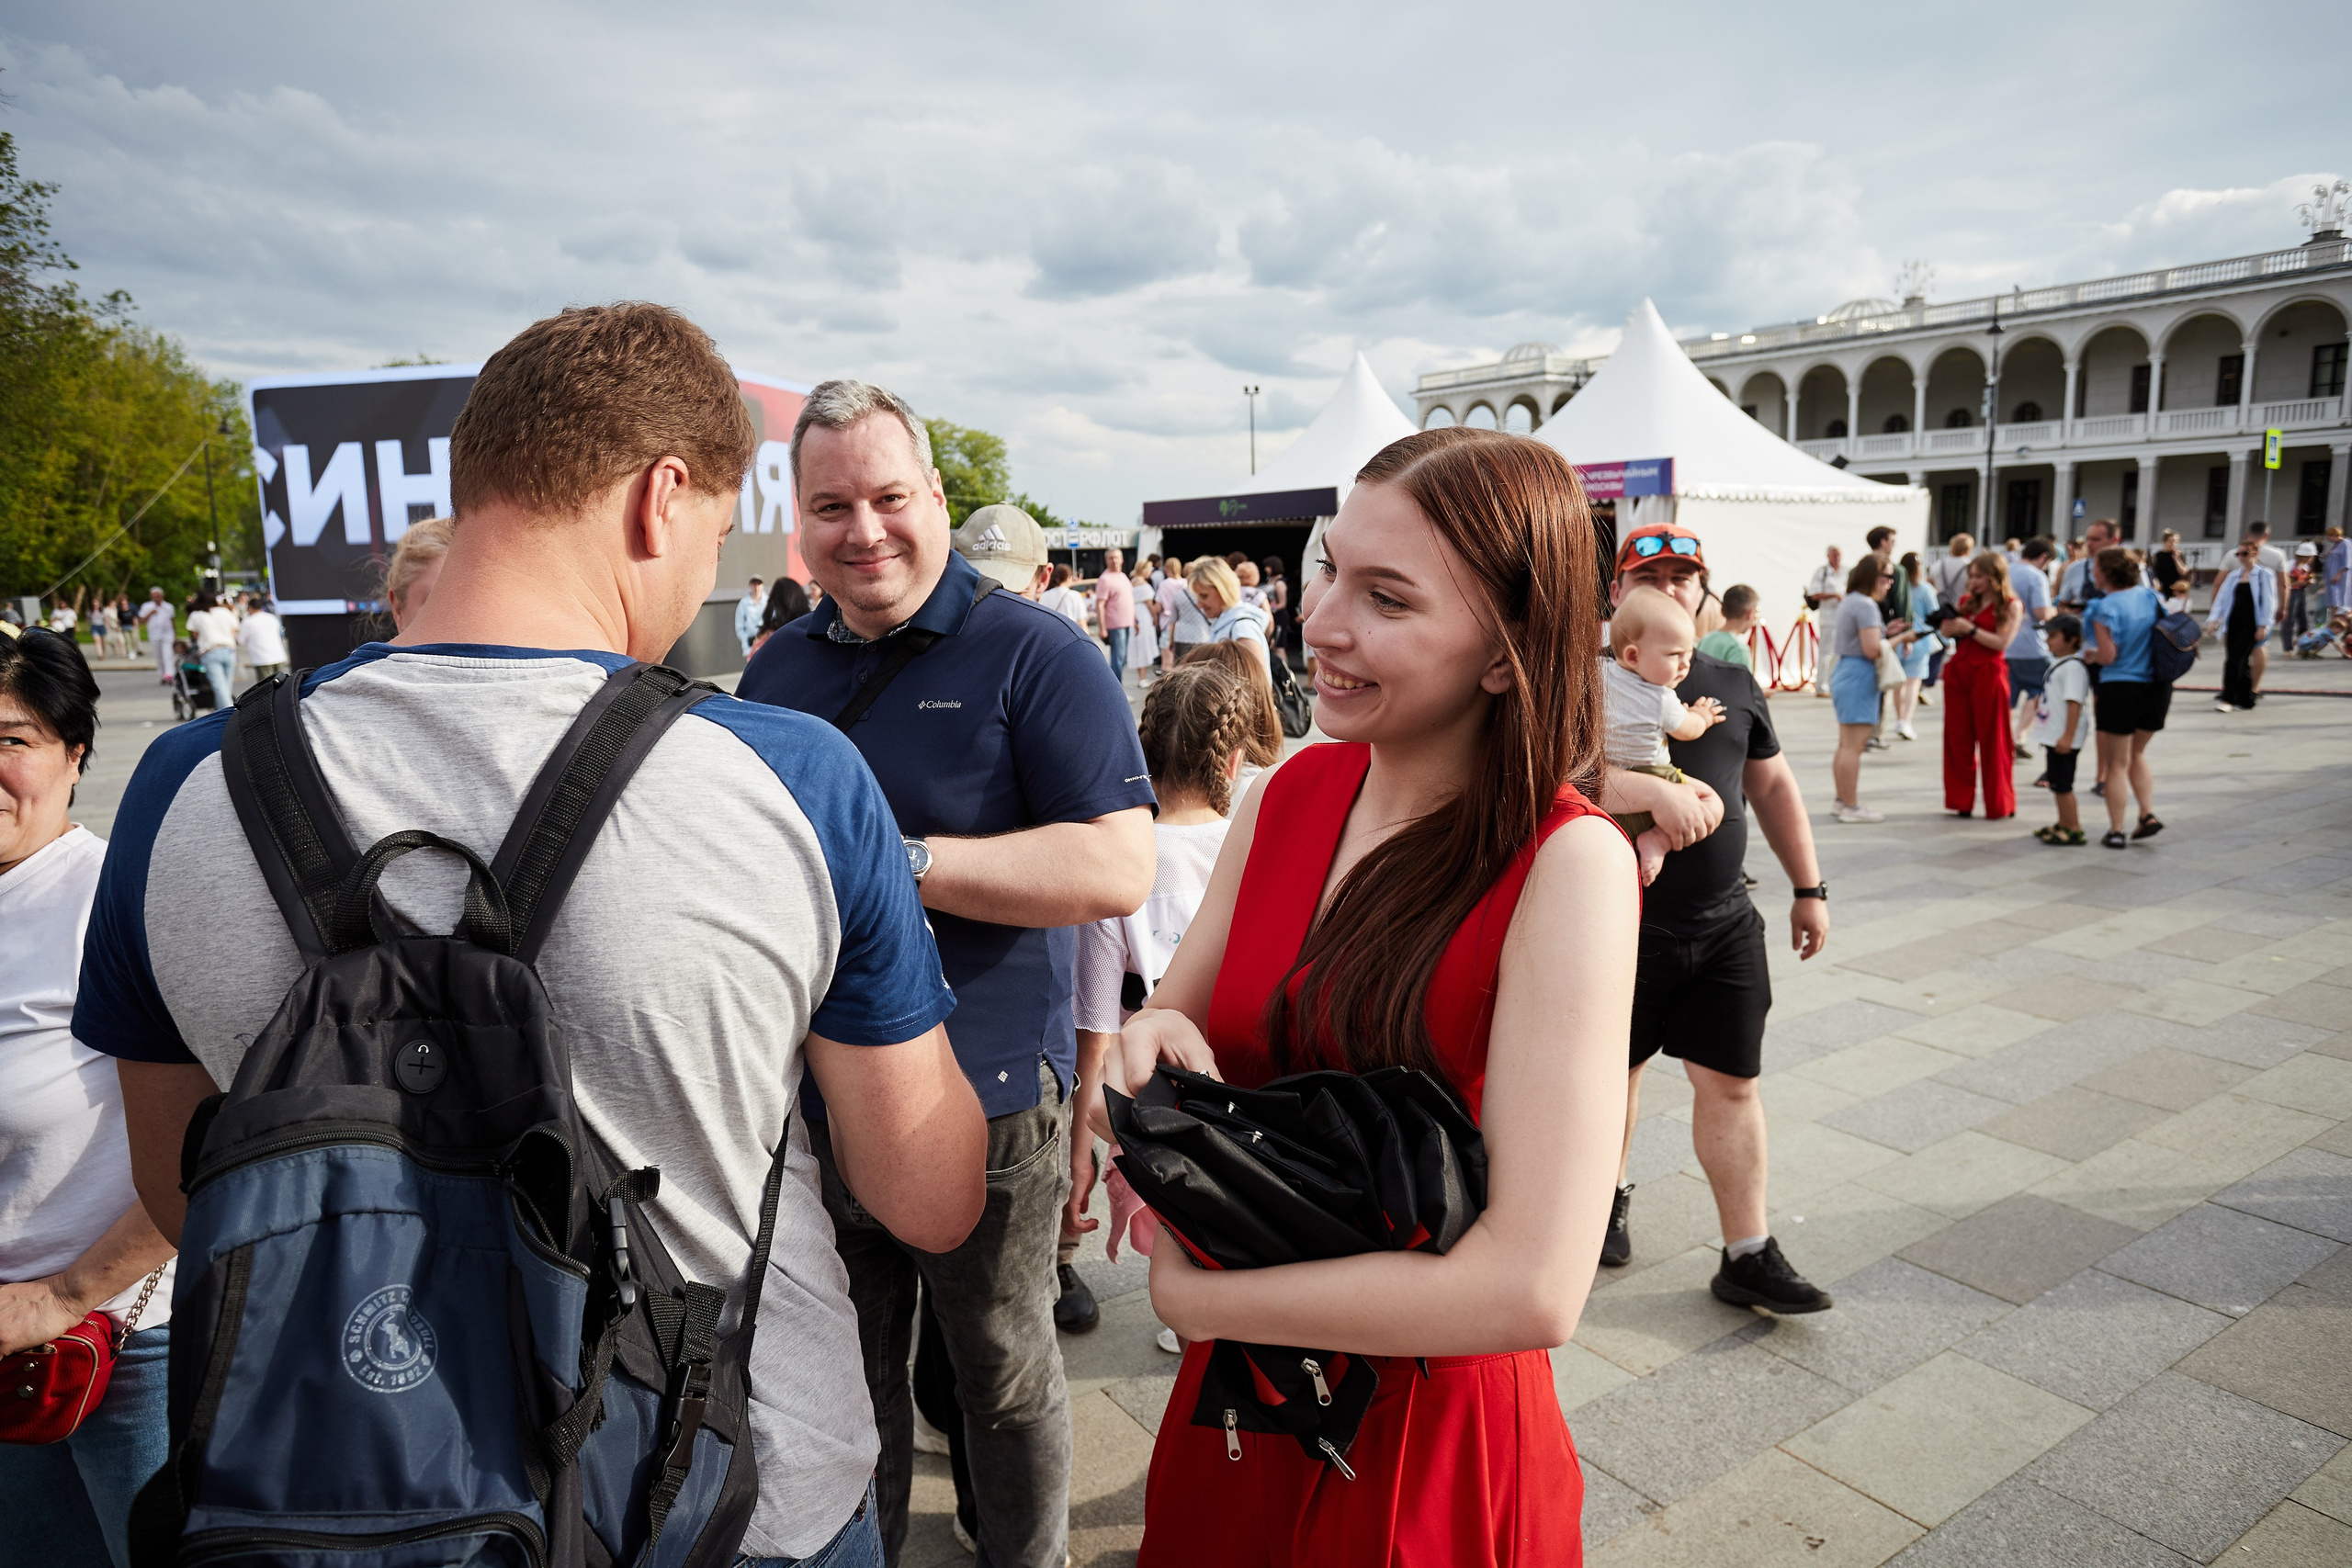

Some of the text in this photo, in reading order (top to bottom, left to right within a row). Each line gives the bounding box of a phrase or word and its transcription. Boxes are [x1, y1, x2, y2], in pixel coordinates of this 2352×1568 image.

[972, 539, 1011, 551] adidas
[926, 699, 962, 708] Columbia
[348, 1291, 396, 1344] SCHMITZ
